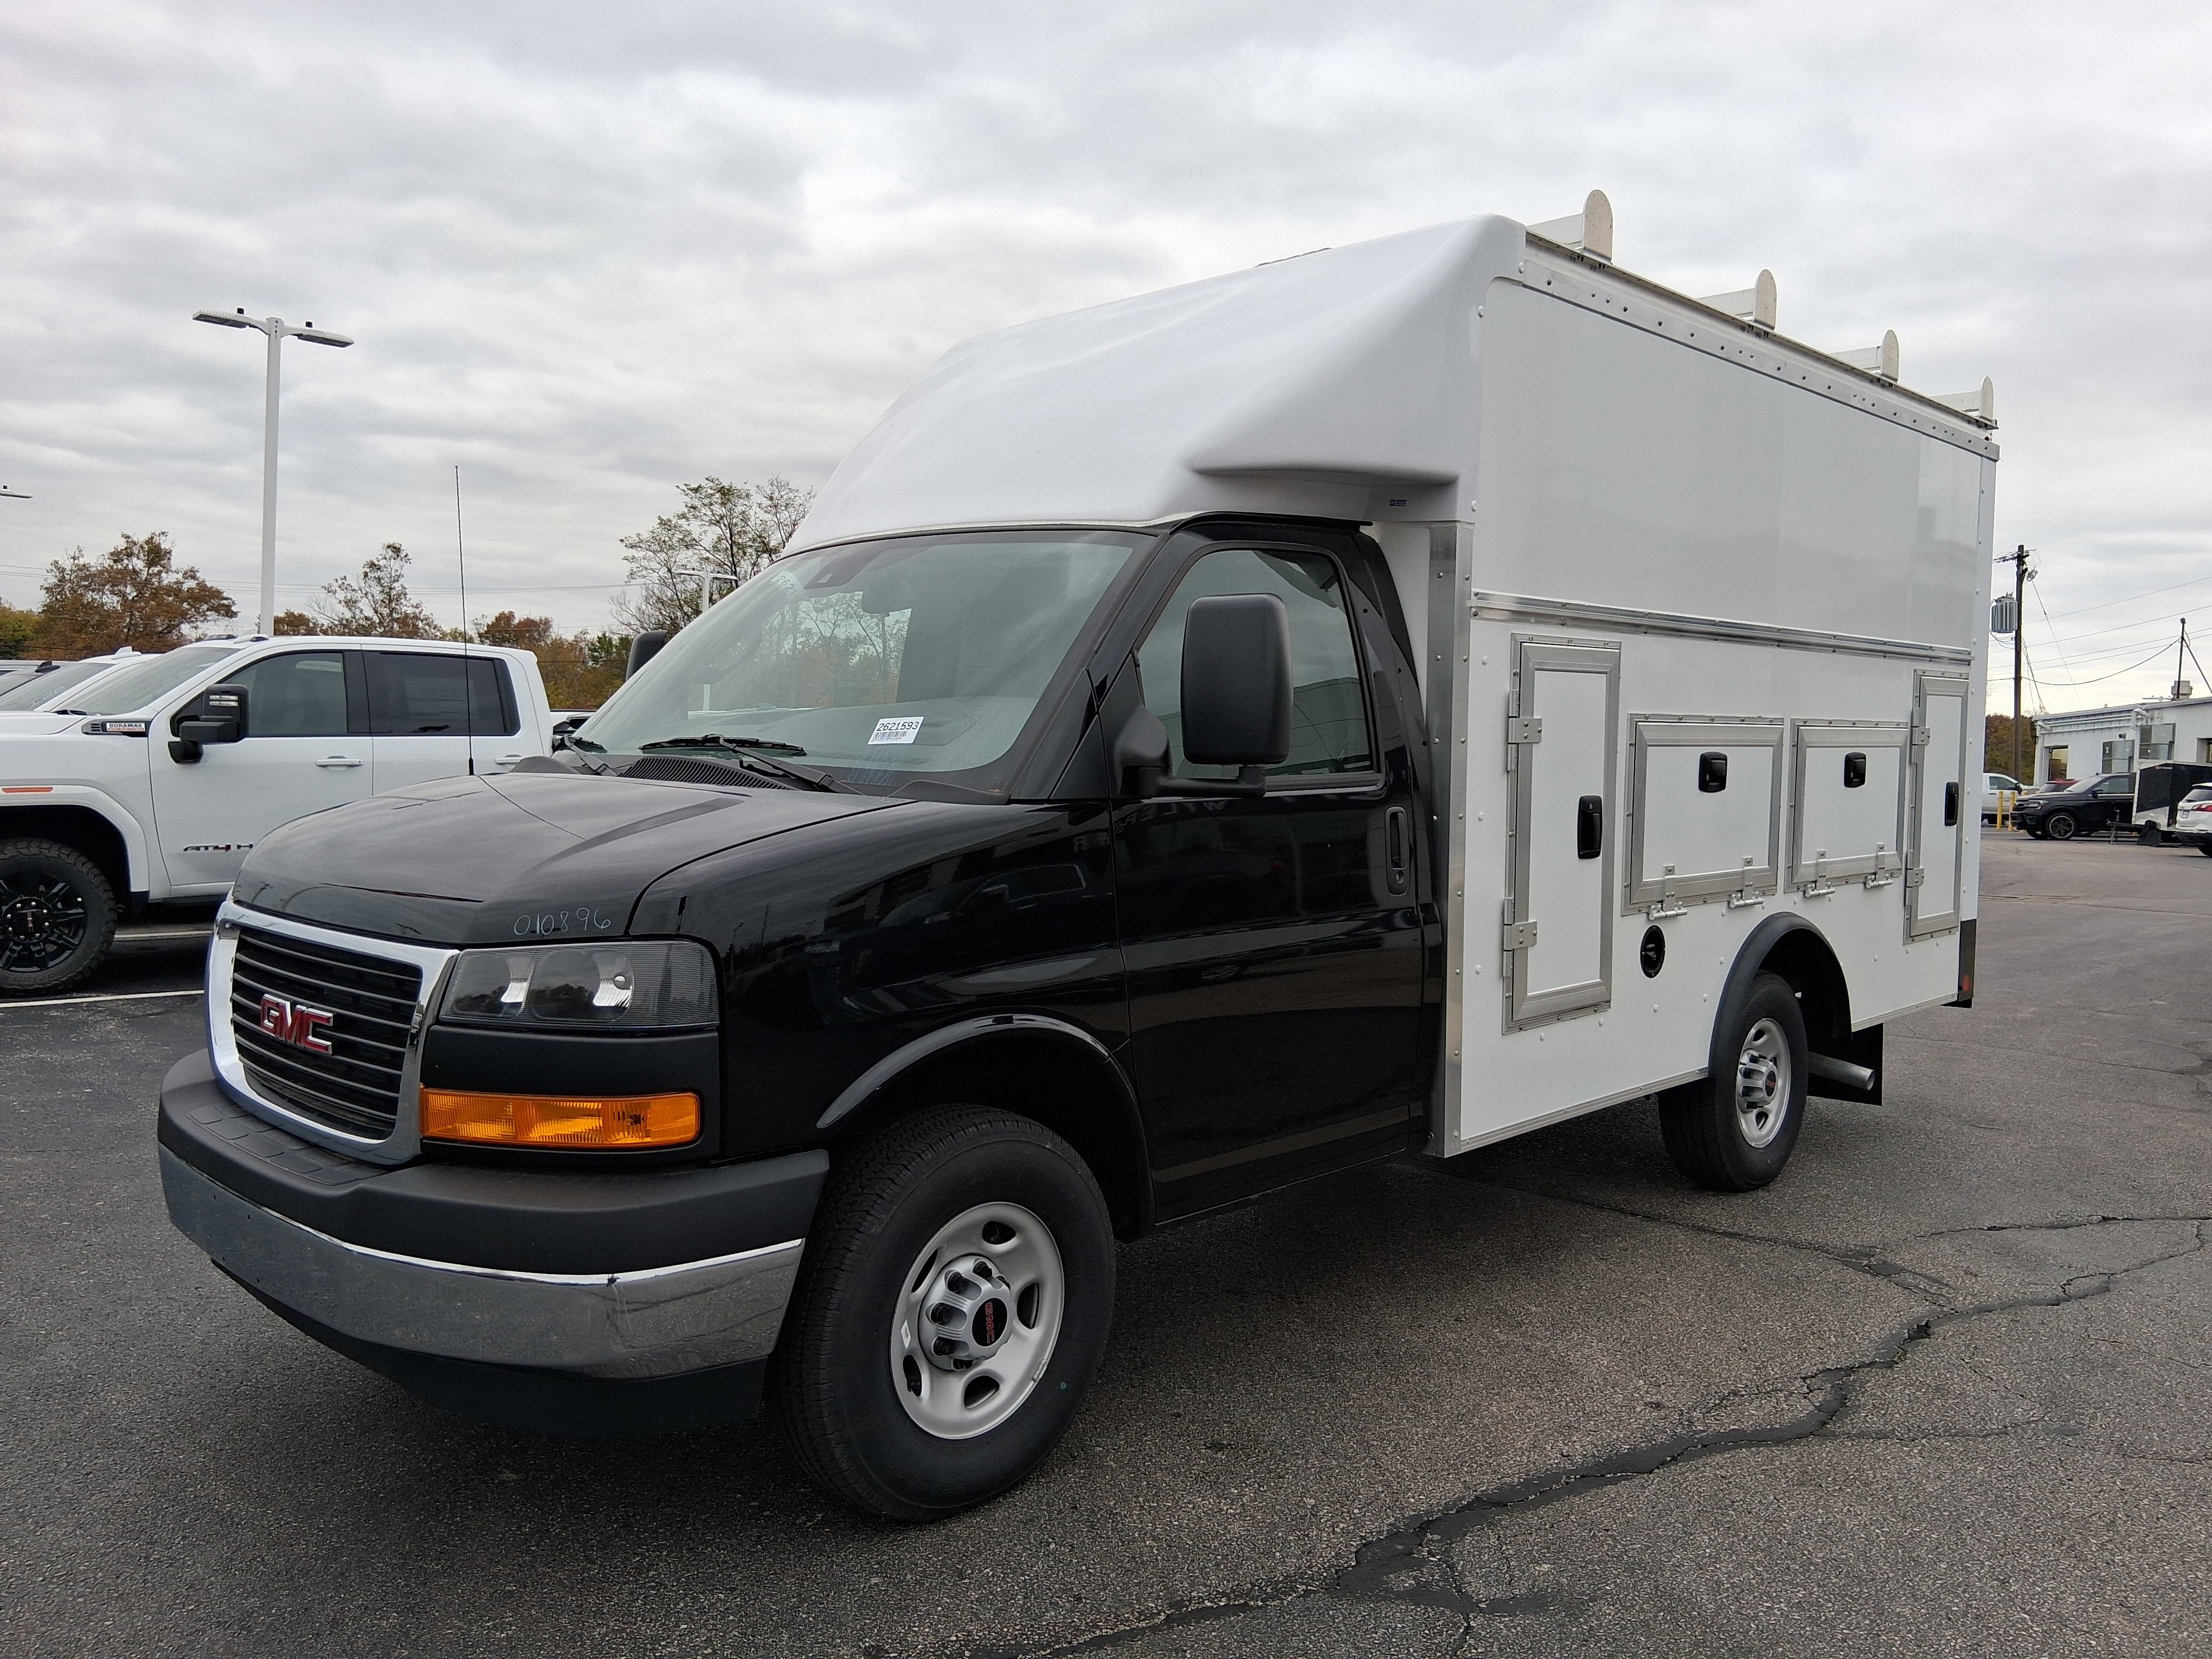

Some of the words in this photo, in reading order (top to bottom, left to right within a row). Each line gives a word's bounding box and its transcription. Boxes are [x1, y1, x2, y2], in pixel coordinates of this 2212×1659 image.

[877, 721, 919, 731] 2621593
[514, 907, 611, 935] 010896
[260, 993, 333, 1055] GMC
[985, 1302, 995, 1344] GMC
